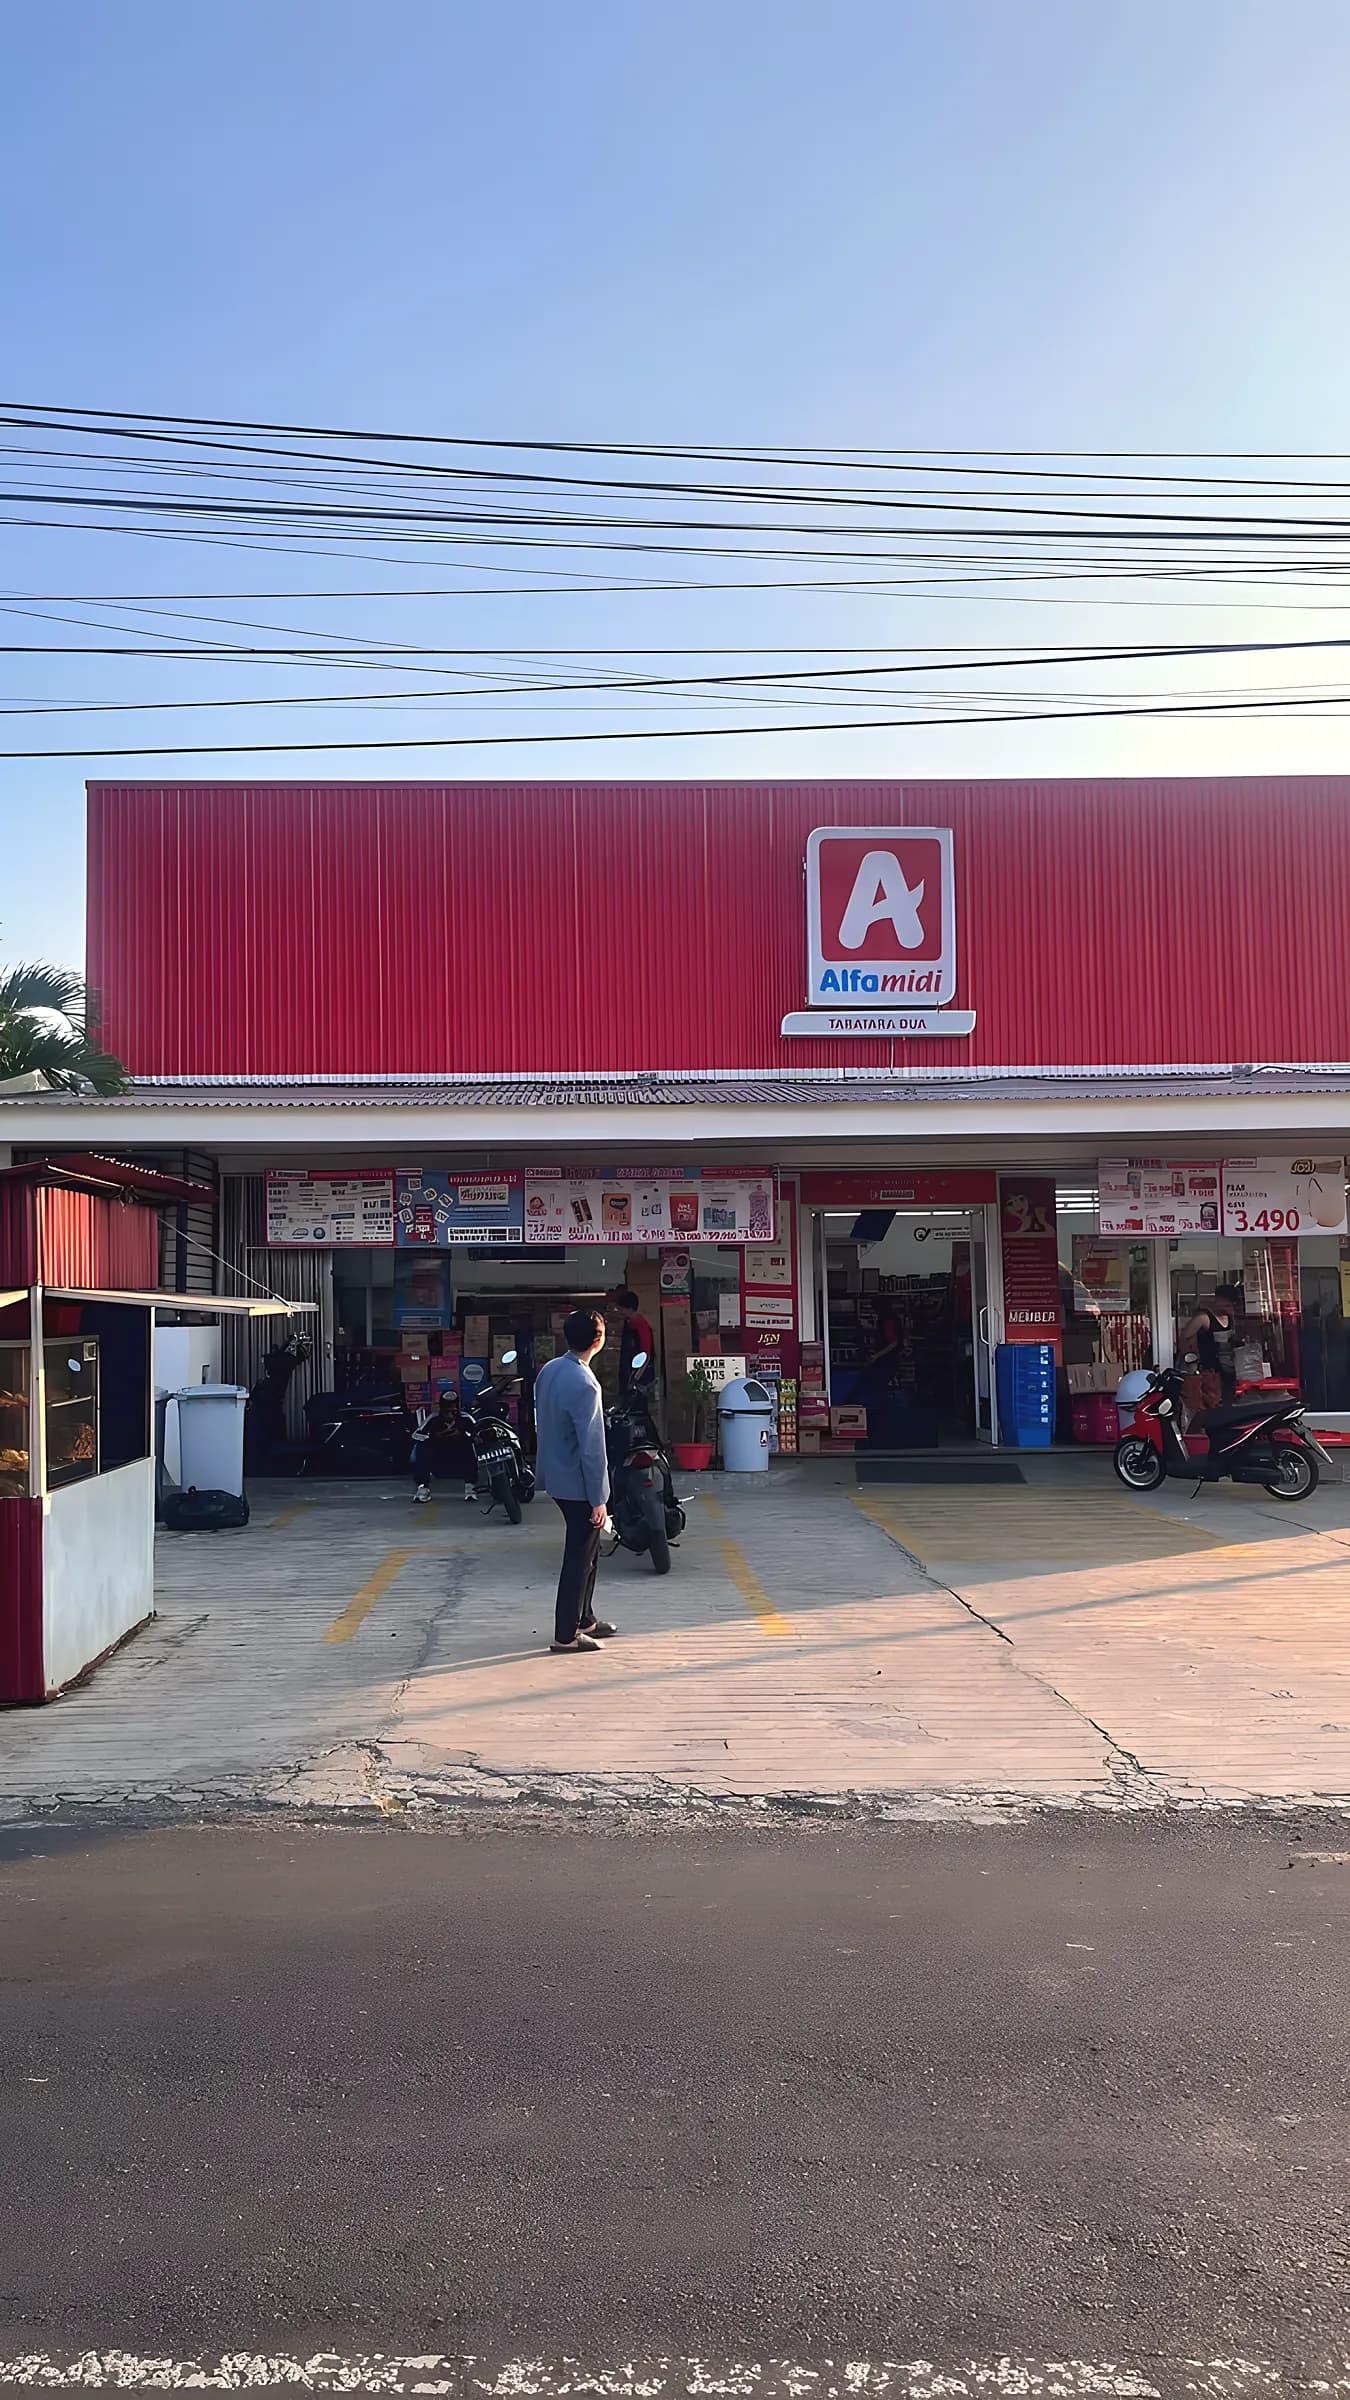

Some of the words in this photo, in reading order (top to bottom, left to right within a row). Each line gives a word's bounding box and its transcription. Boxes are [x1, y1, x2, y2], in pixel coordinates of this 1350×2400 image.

[838, 850, 925, 950] A
[819, 968, 943, 993] Alfamidi
[828, 1018, 896, 1030] TARATARA
[899, 1018, 927, 1030] DUA
[1234, 1208, 1300, 1232] 3.490
[1008, 1311, 1056, 1323] MEMBER
